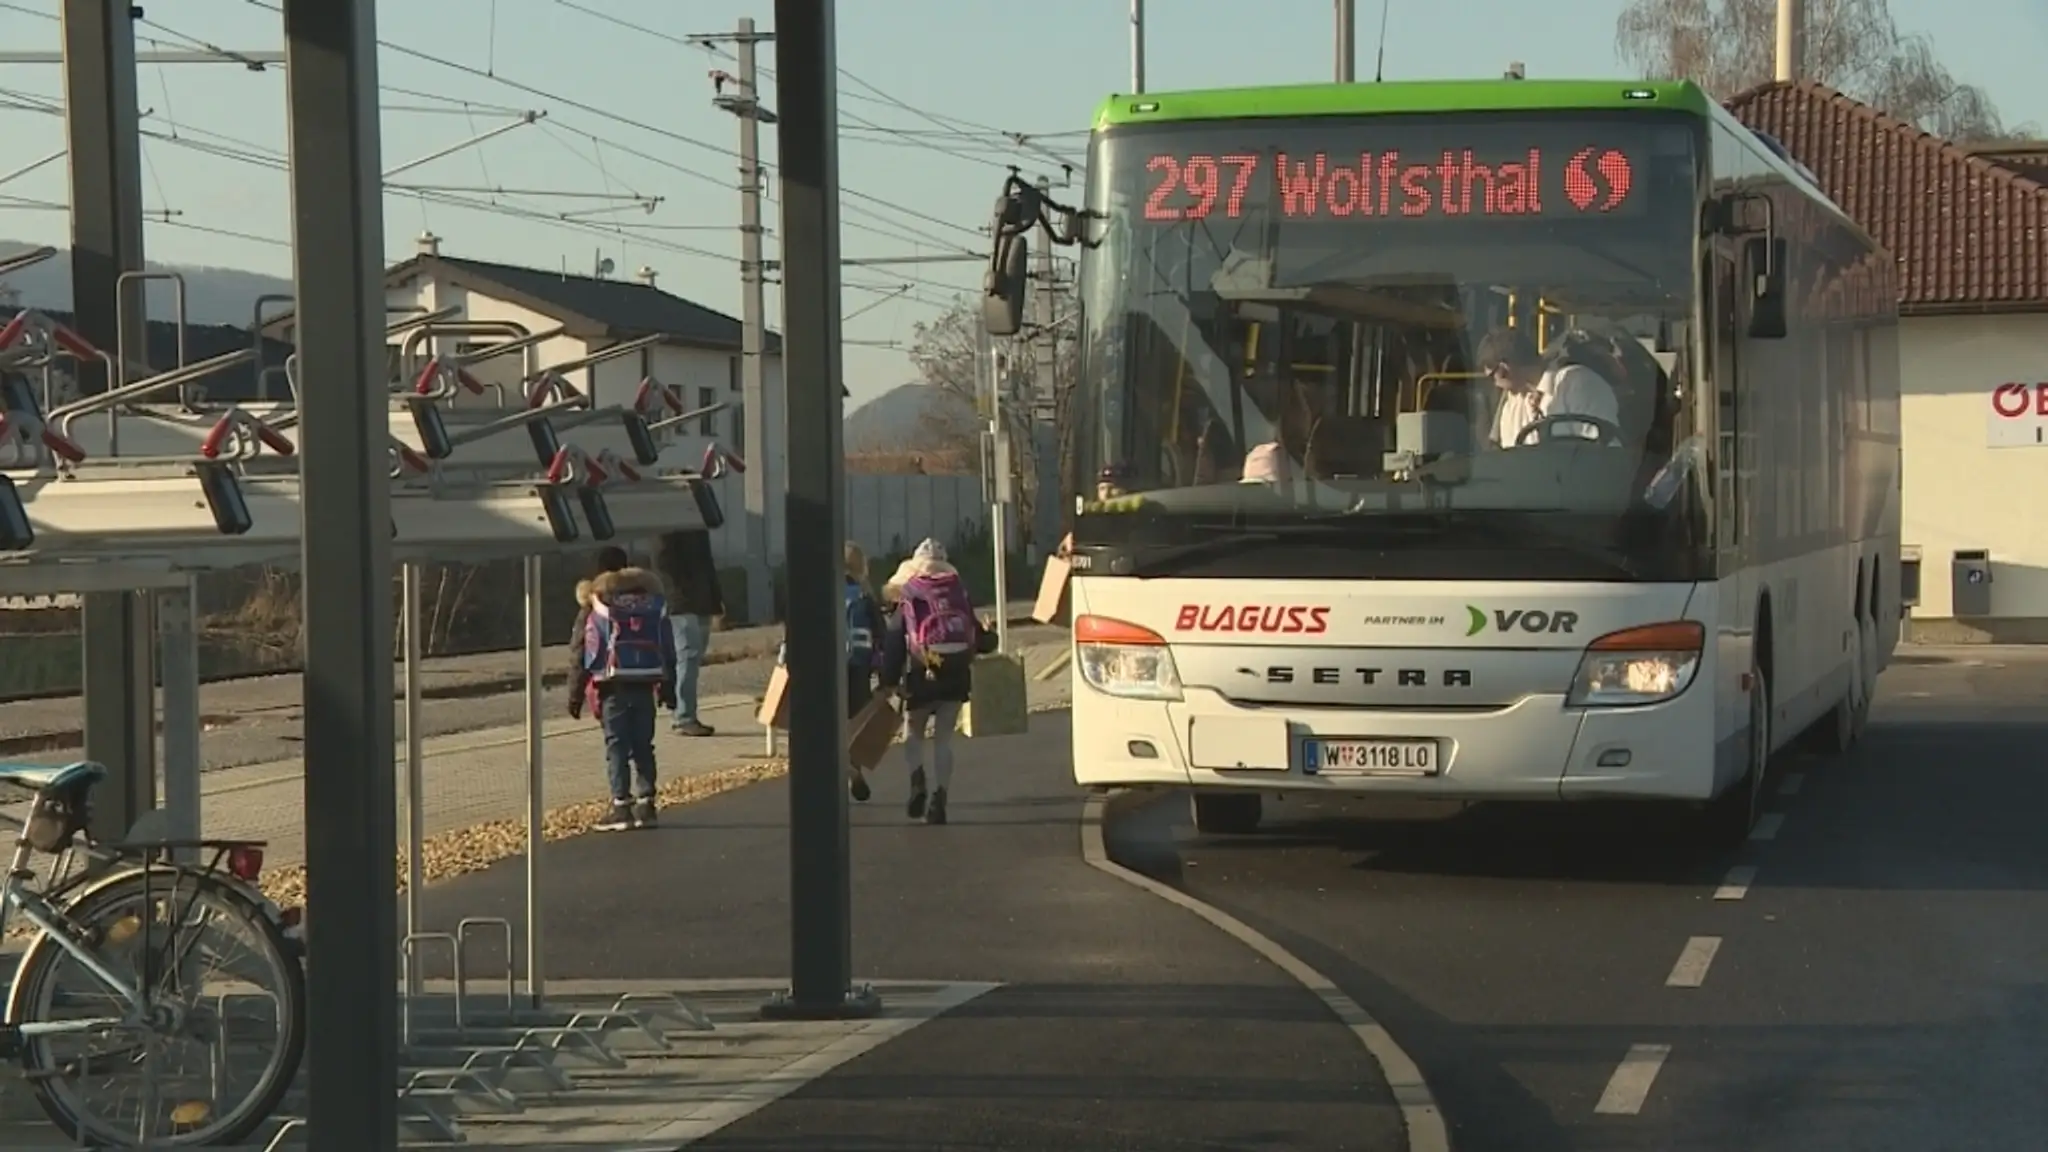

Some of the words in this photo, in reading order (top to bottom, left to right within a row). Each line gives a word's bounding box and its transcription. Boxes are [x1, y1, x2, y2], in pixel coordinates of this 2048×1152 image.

[1143, 155, 1257, 219] 297
[1276, 148, 1542, 217] Wolfsthal
[1175, 604, 1331, 634] BLAGUSS
[1363, 615, 1426, 625] PARTNER
[1428, 615, 1445, 625] IM
[1493, 609, 1578, 633] VOR
[1267, 666, 1472, 687] SETRA
[1325, 745, 1340, 766] W
[1355, 745, 1400, 767] 3118
